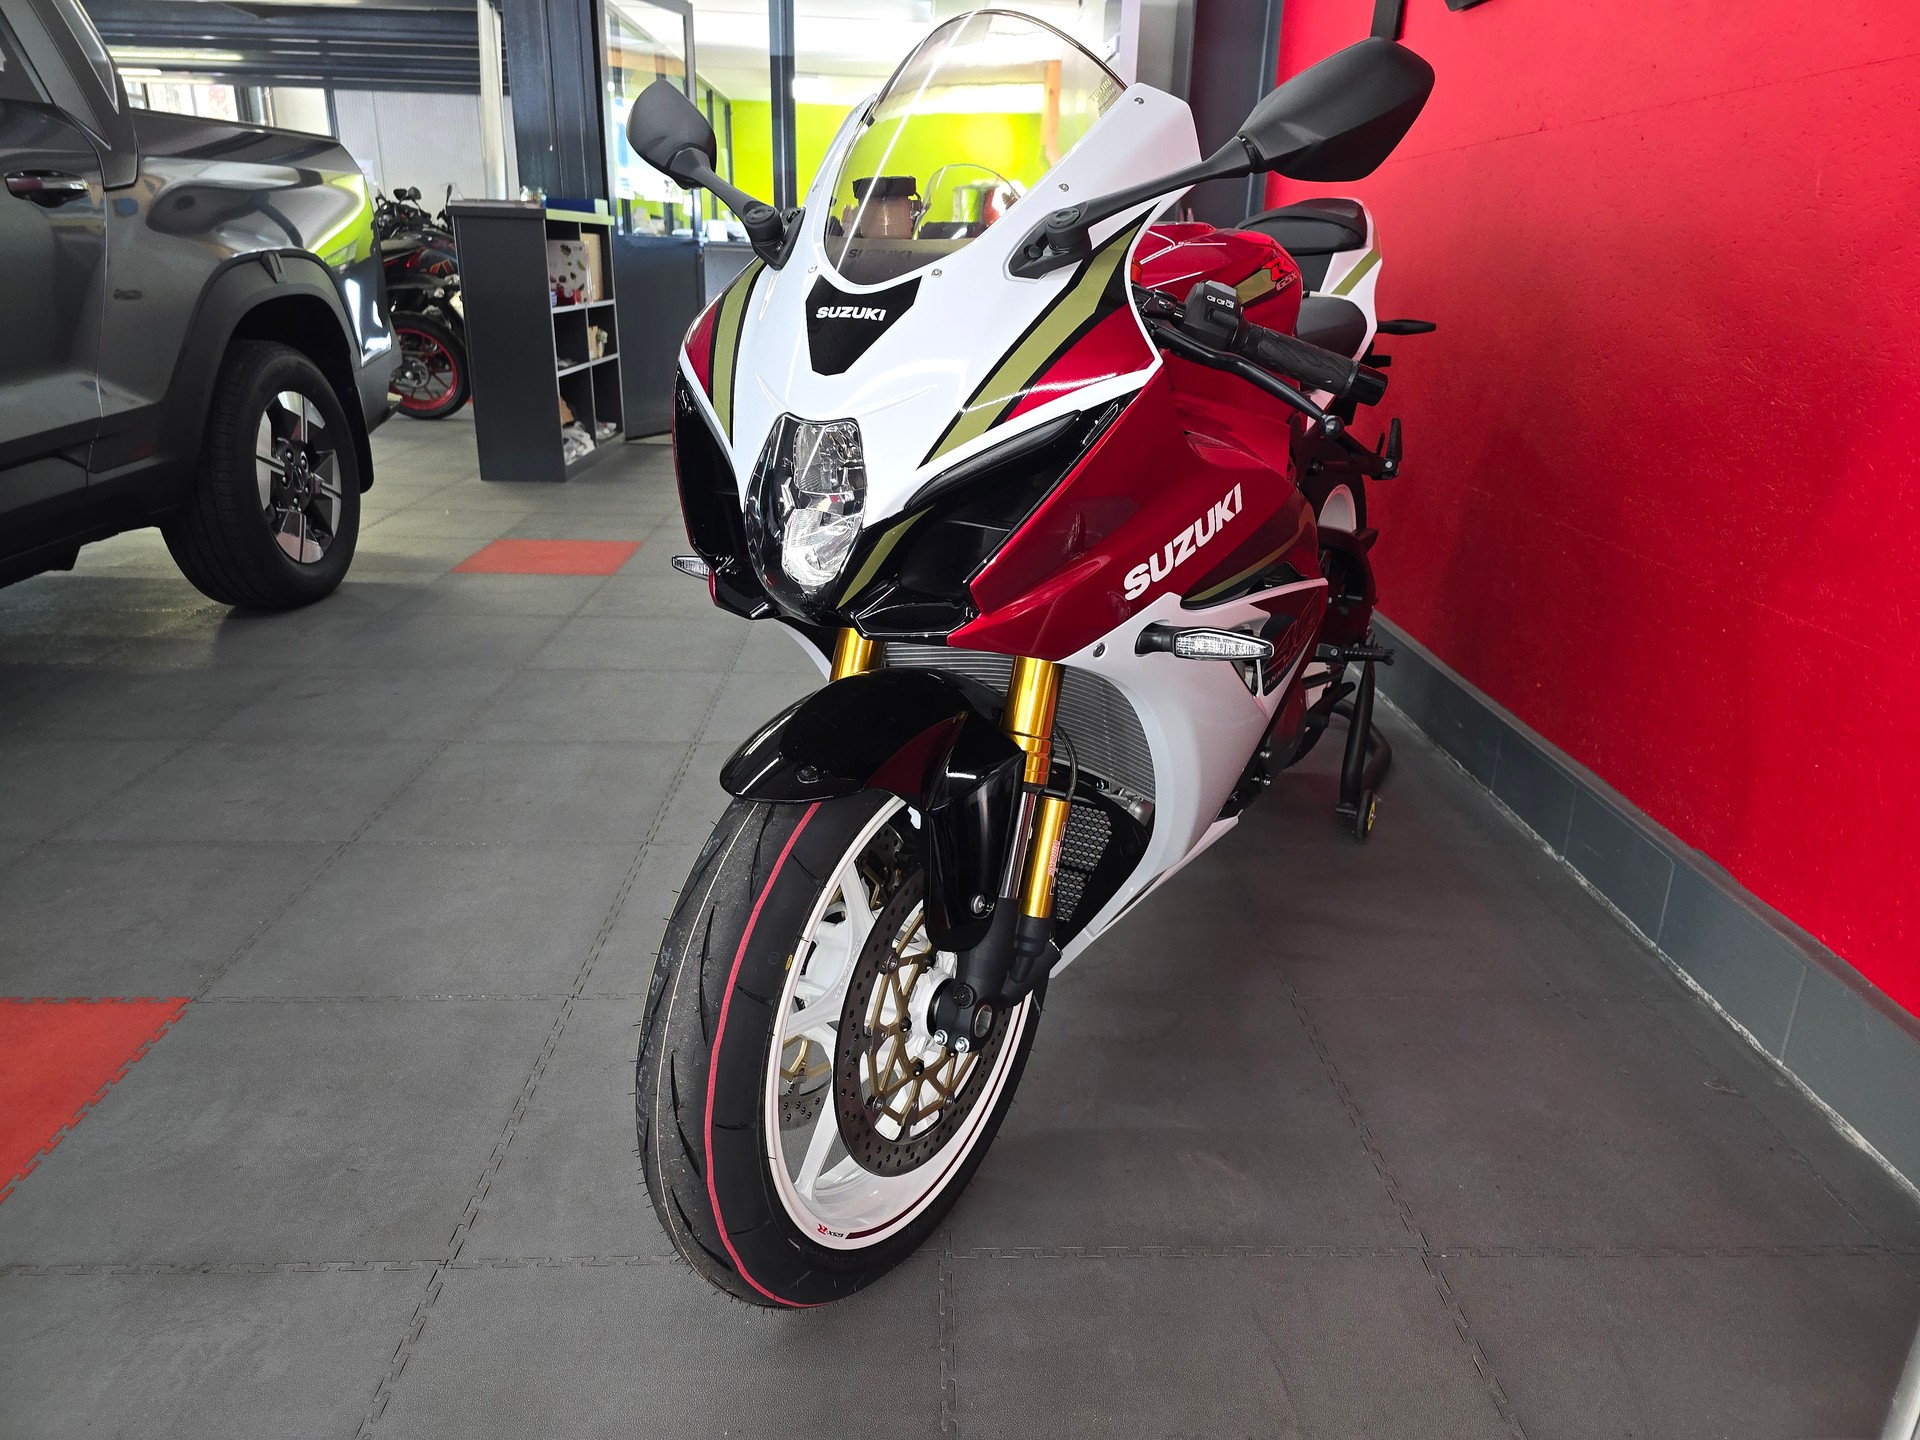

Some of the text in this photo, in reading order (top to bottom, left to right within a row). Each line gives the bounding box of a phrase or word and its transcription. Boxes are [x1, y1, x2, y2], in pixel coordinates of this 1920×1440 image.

[1276, 271, 1298, 291] GSX
[815, 306, 887, 321] SUZUKI
[1123, 482, 1243, 601] SUZUKI
